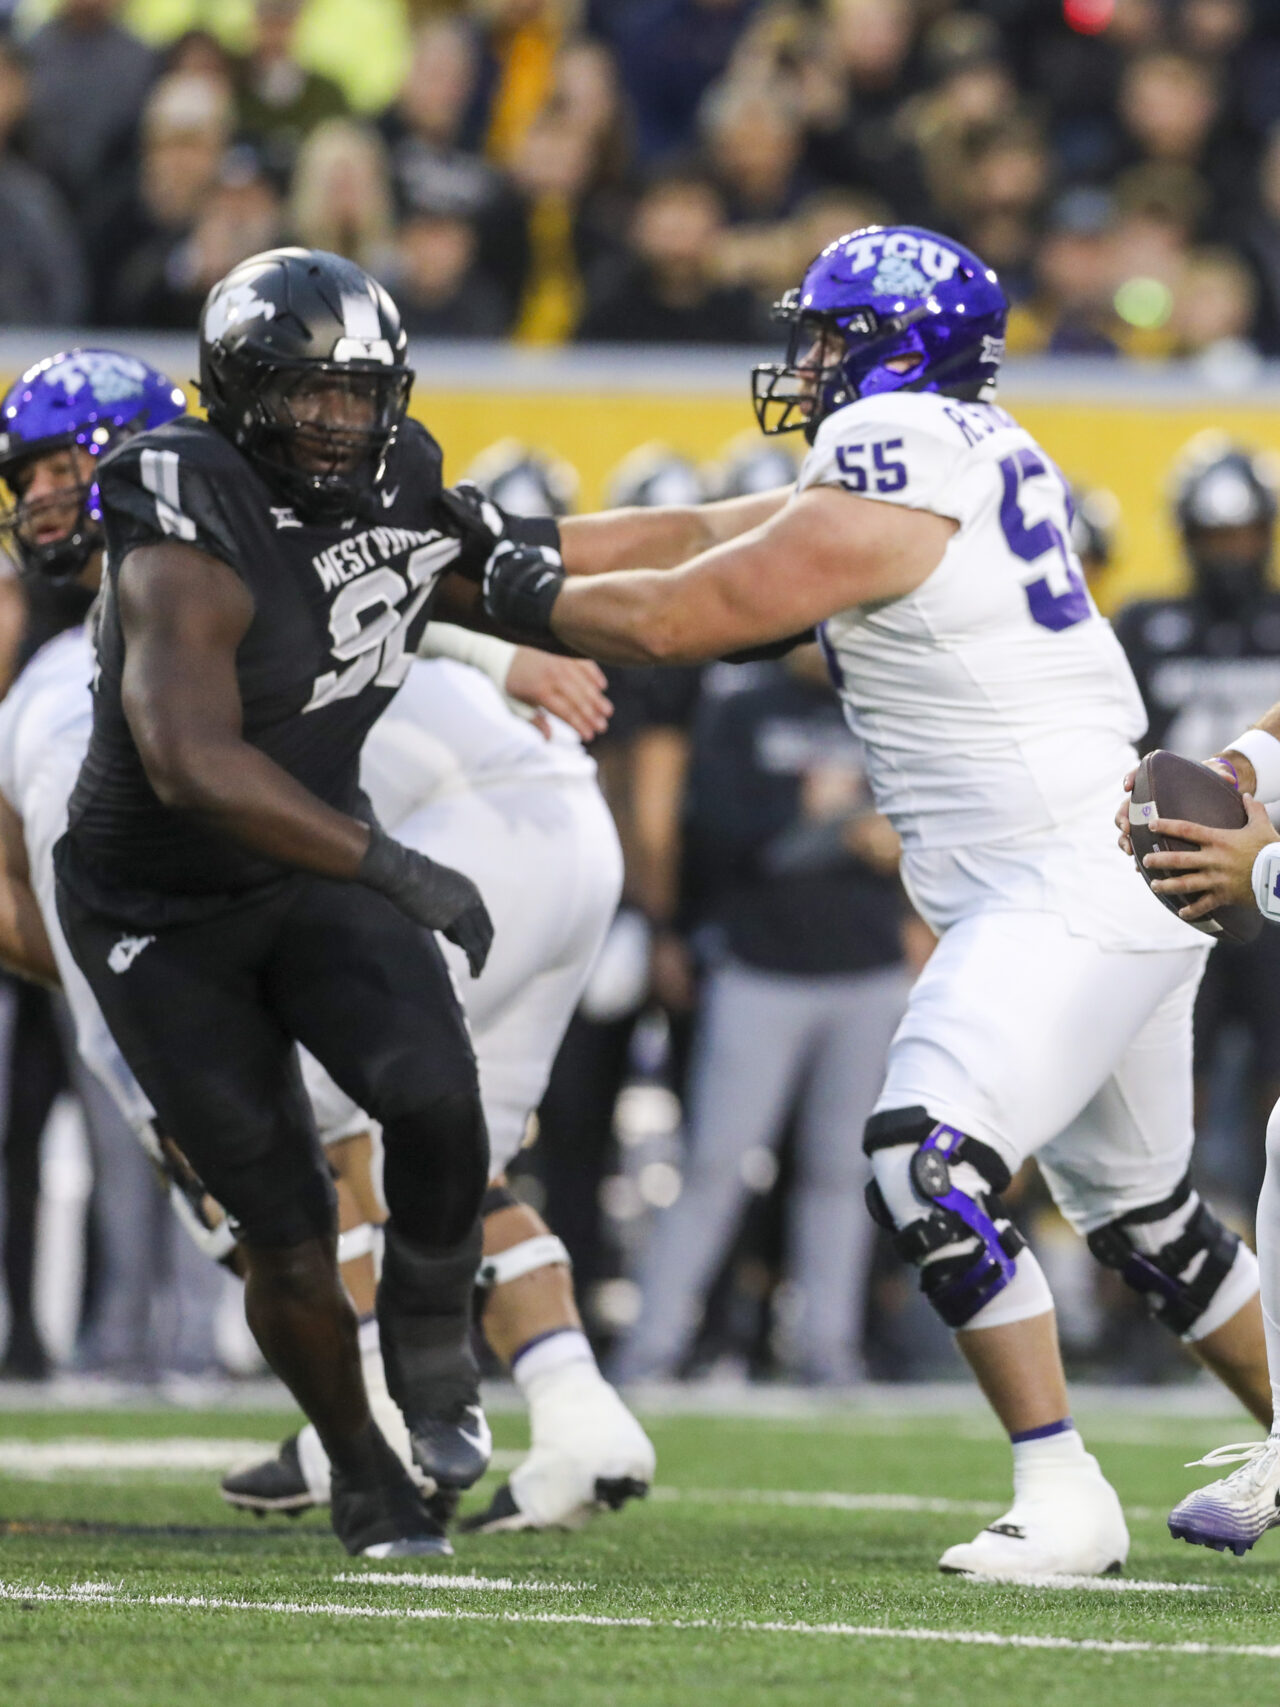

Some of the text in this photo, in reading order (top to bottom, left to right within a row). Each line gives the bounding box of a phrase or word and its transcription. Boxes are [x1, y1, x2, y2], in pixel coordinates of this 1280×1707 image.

[845, 233, 960, 282] TCU
[835, 438, 908, 494] 55
[312, 531, 376, 592] WEST
